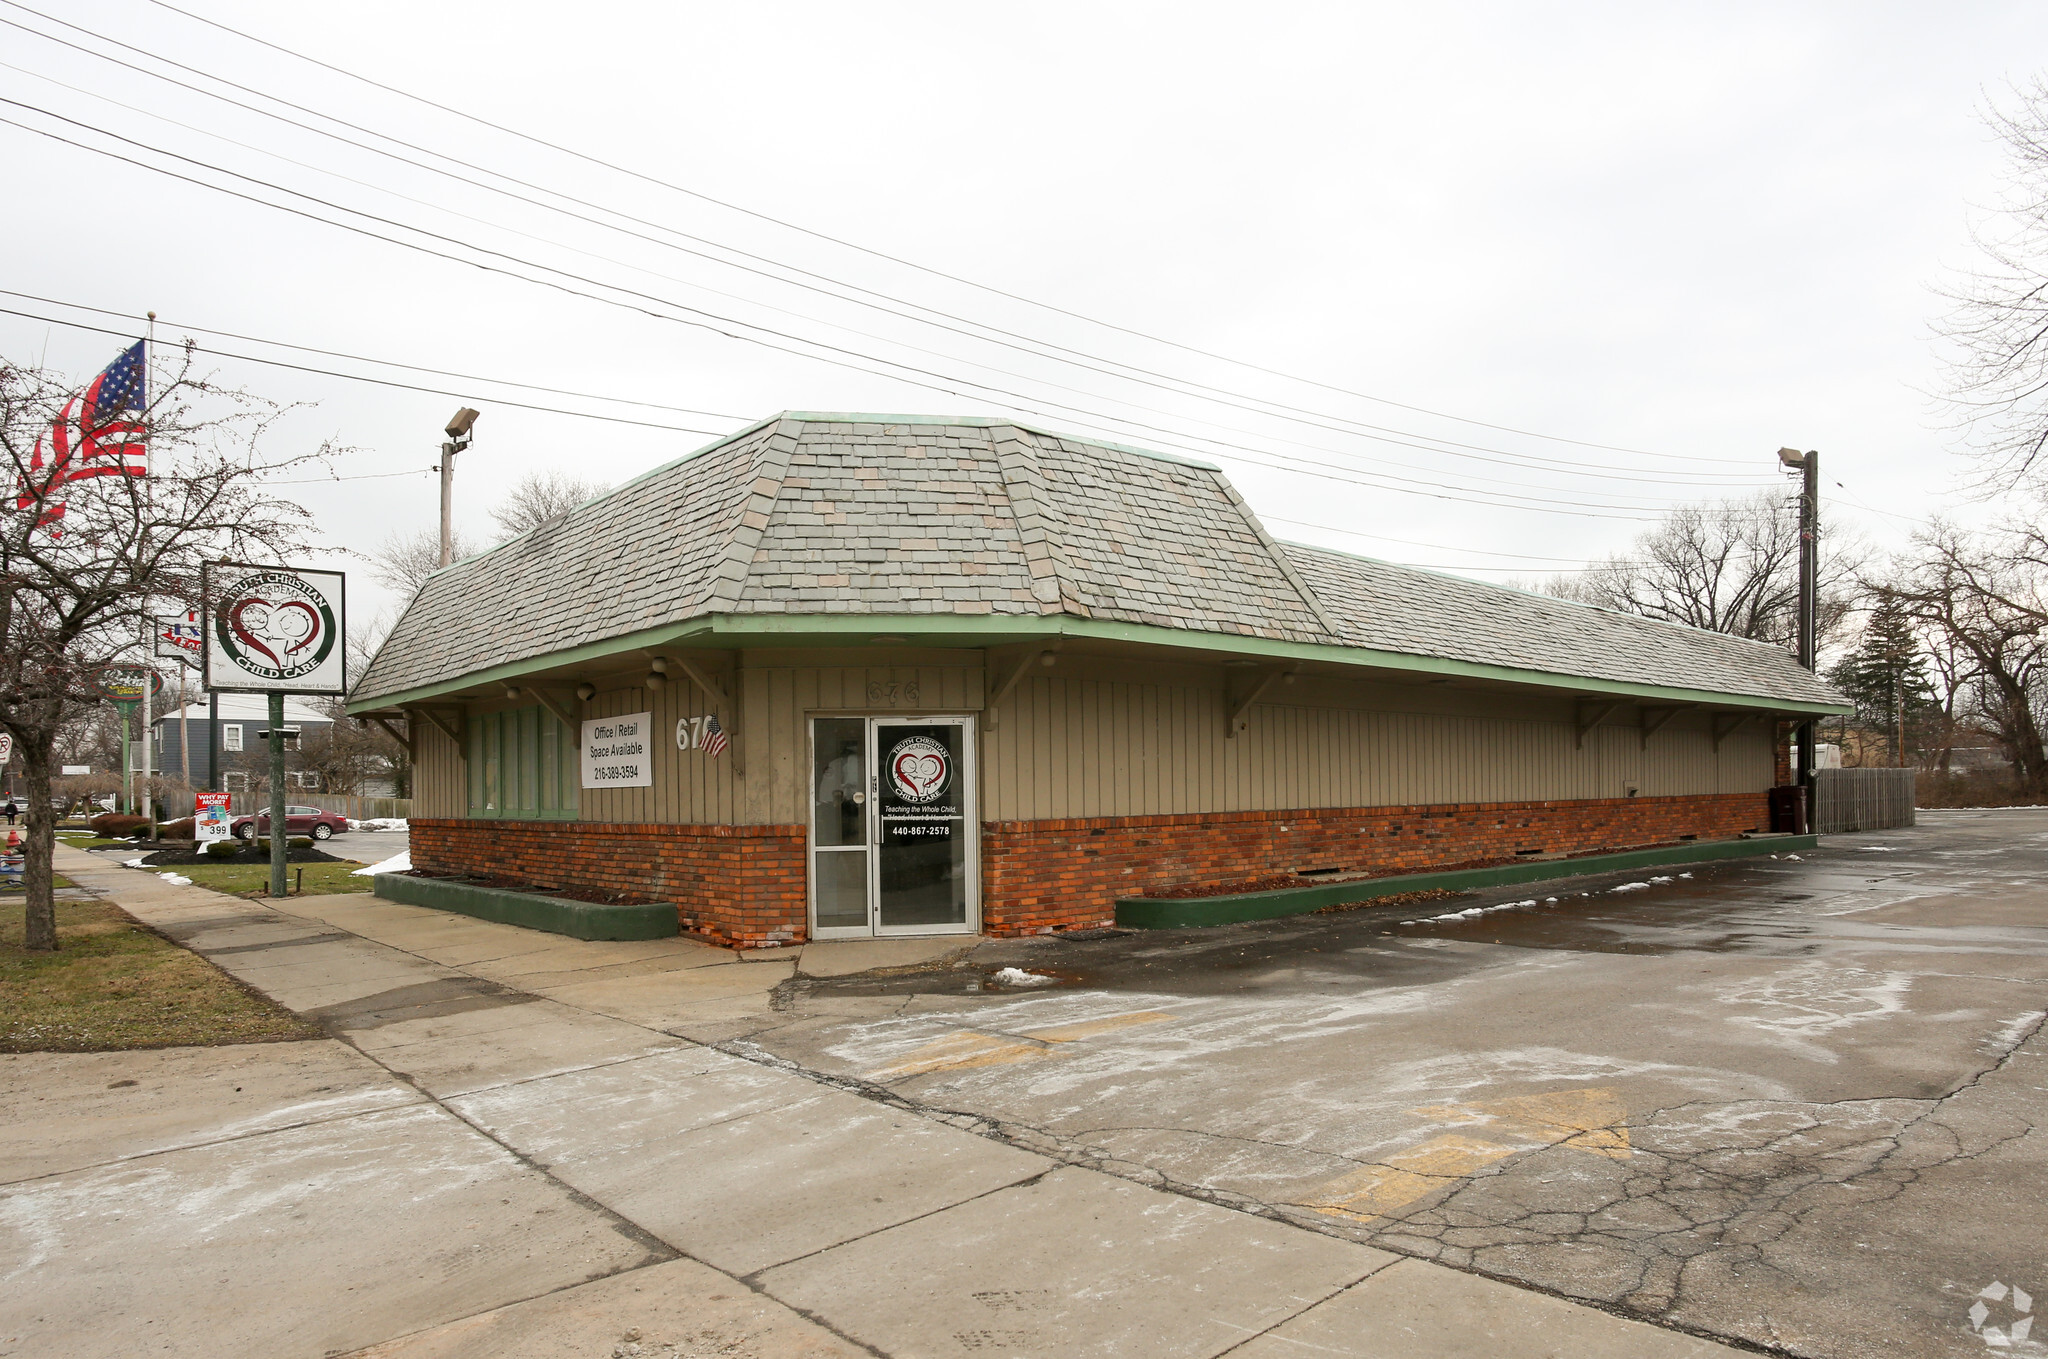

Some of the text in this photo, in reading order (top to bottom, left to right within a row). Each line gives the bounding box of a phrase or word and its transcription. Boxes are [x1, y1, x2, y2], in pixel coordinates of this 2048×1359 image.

[254, 585, 304, 598] ACADEMY
[267, 574, 327, 607] CHRISTIAN
[236, 656, 320, 678] CHILD CARE
[867, 680, 919, 704] 676
[594, 723, 638, 740] Office / Retail
[590, 742, 643, 760] Space Available
[893, 737, 948, 758] TRUTH CHRISTIAN
[908, 744, 934, 752] ACADEMY
[594, 765, 638, 780] 216-389-3594
[895, 788, 942, 802] CHILD CARE
[885, 805, 910, 813] Teaching
[210, 826, 226, 834] 399
[893, 826, 950, 836] 440-867-2578
